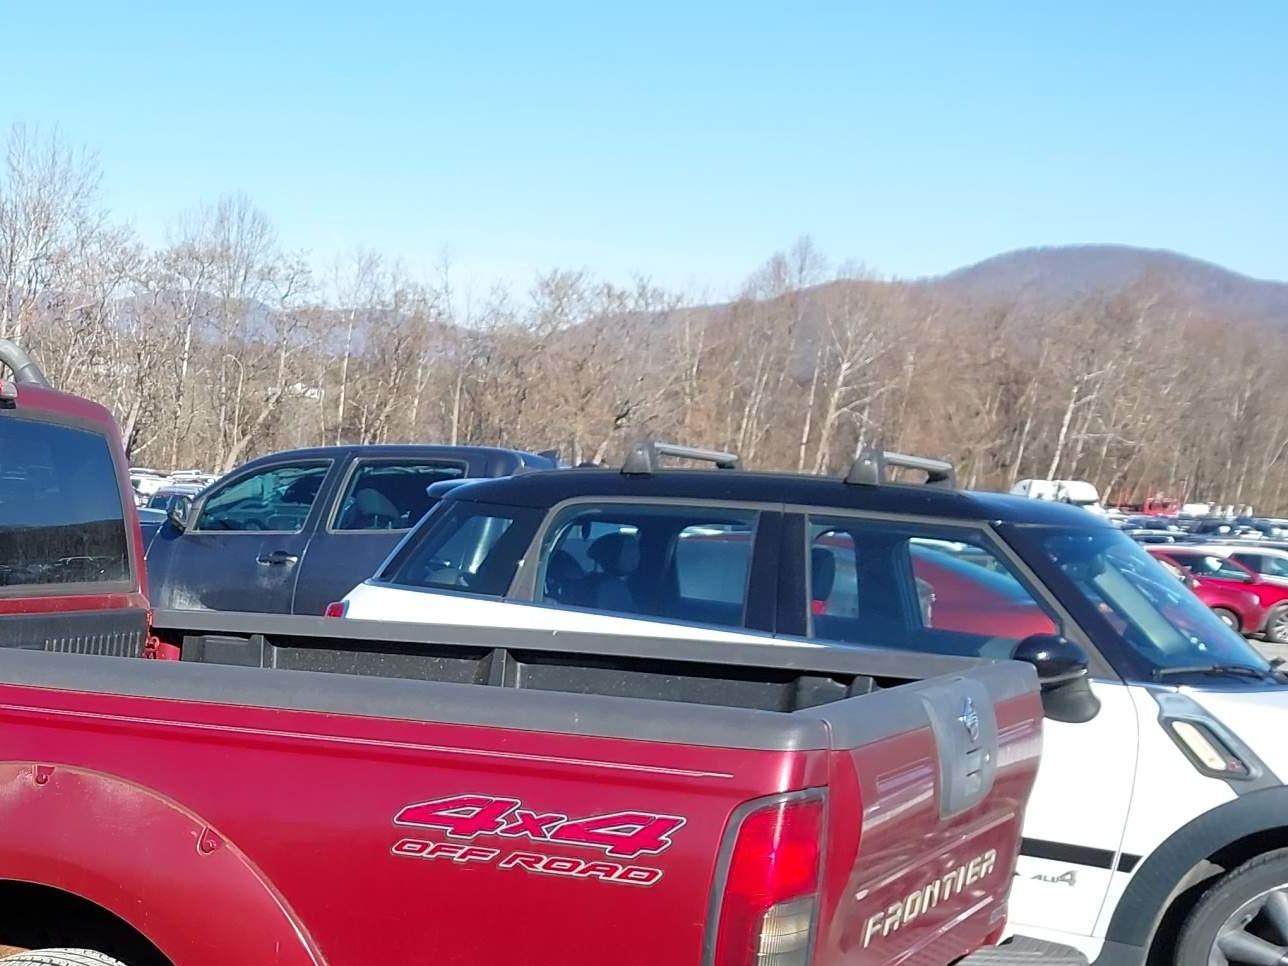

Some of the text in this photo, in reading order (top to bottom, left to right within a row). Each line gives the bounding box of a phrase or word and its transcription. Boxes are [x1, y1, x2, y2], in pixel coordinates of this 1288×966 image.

[393, 793, 688, 858] 4x4
[391, 837, 664, 886] OFF ROAD
[862, 849, 997, 948] FRONTIER
